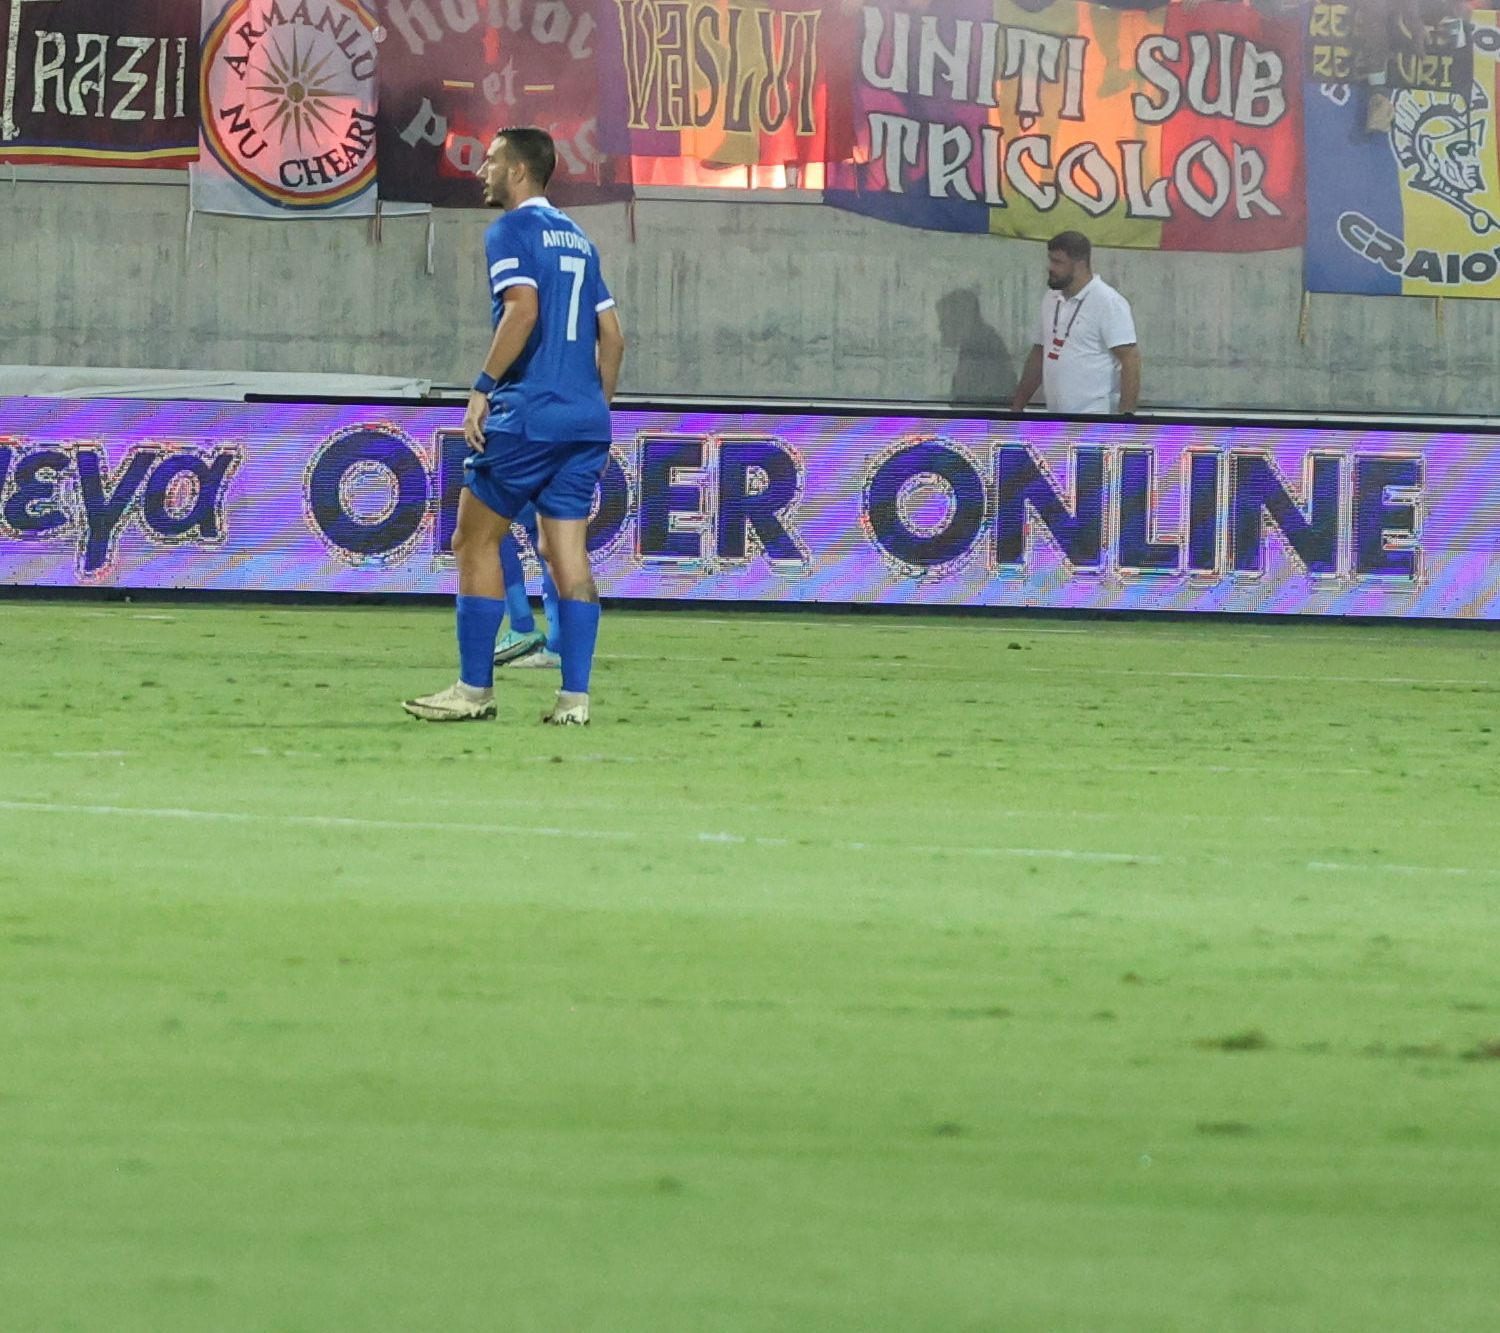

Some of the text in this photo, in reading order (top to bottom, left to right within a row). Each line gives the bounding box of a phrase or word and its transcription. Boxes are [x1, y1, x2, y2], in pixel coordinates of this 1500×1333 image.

[482, 54, 518, 106] et
[1133, 32, 1287, 128] SUB
[219, 101, 378, 191] NU CHEARI
[866, 112, 1282, 222] TRICOLOR
[559, 254, 586, 342] 7
[302, 423, 1426, 589] OER ONLINE
